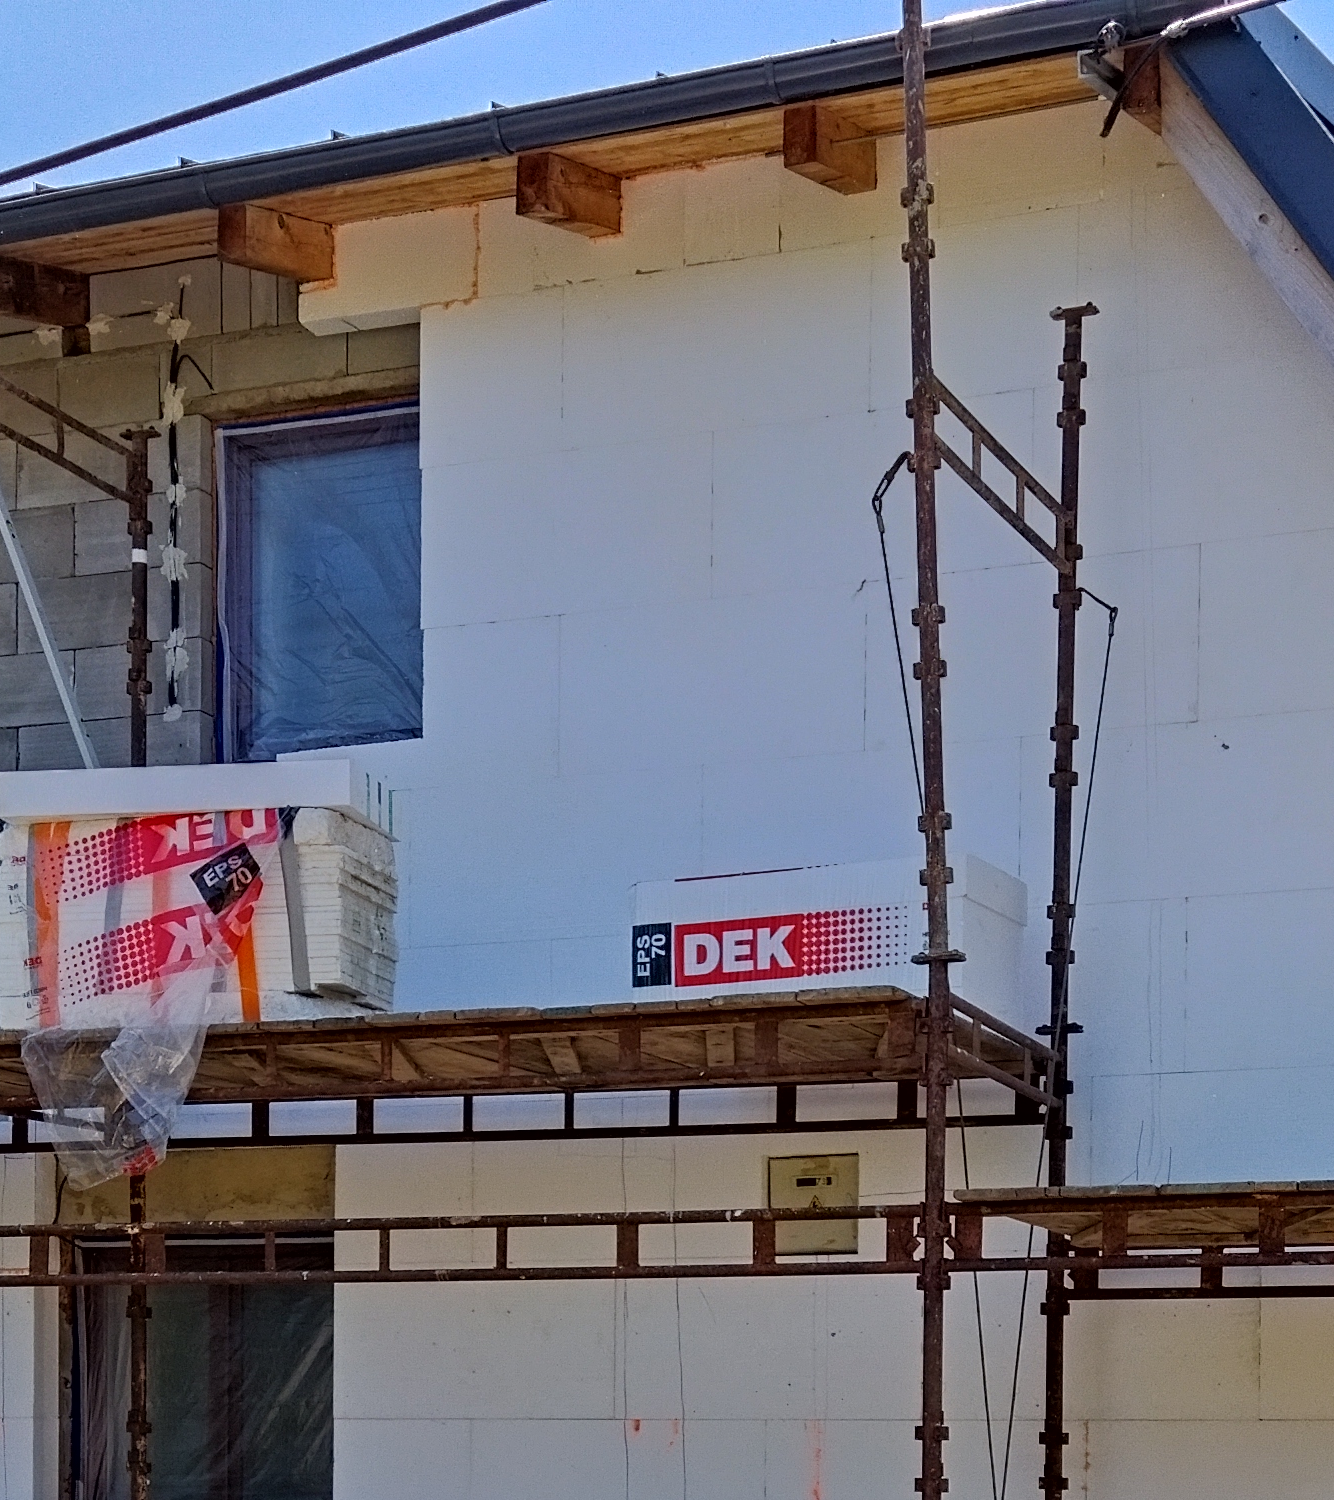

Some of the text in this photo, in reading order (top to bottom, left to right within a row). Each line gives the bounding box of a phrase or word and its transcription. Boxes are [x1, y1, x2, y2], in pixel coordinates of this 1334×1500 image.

[150, 809, 267, 864] DEK
[203, 855, 243, 888] EPS
[225, 867, 253, 892] 70
[637, 934, 651, 977] EPS
[652, 933, 666, 959] 70
[683, 925, 796, 977] DEK
